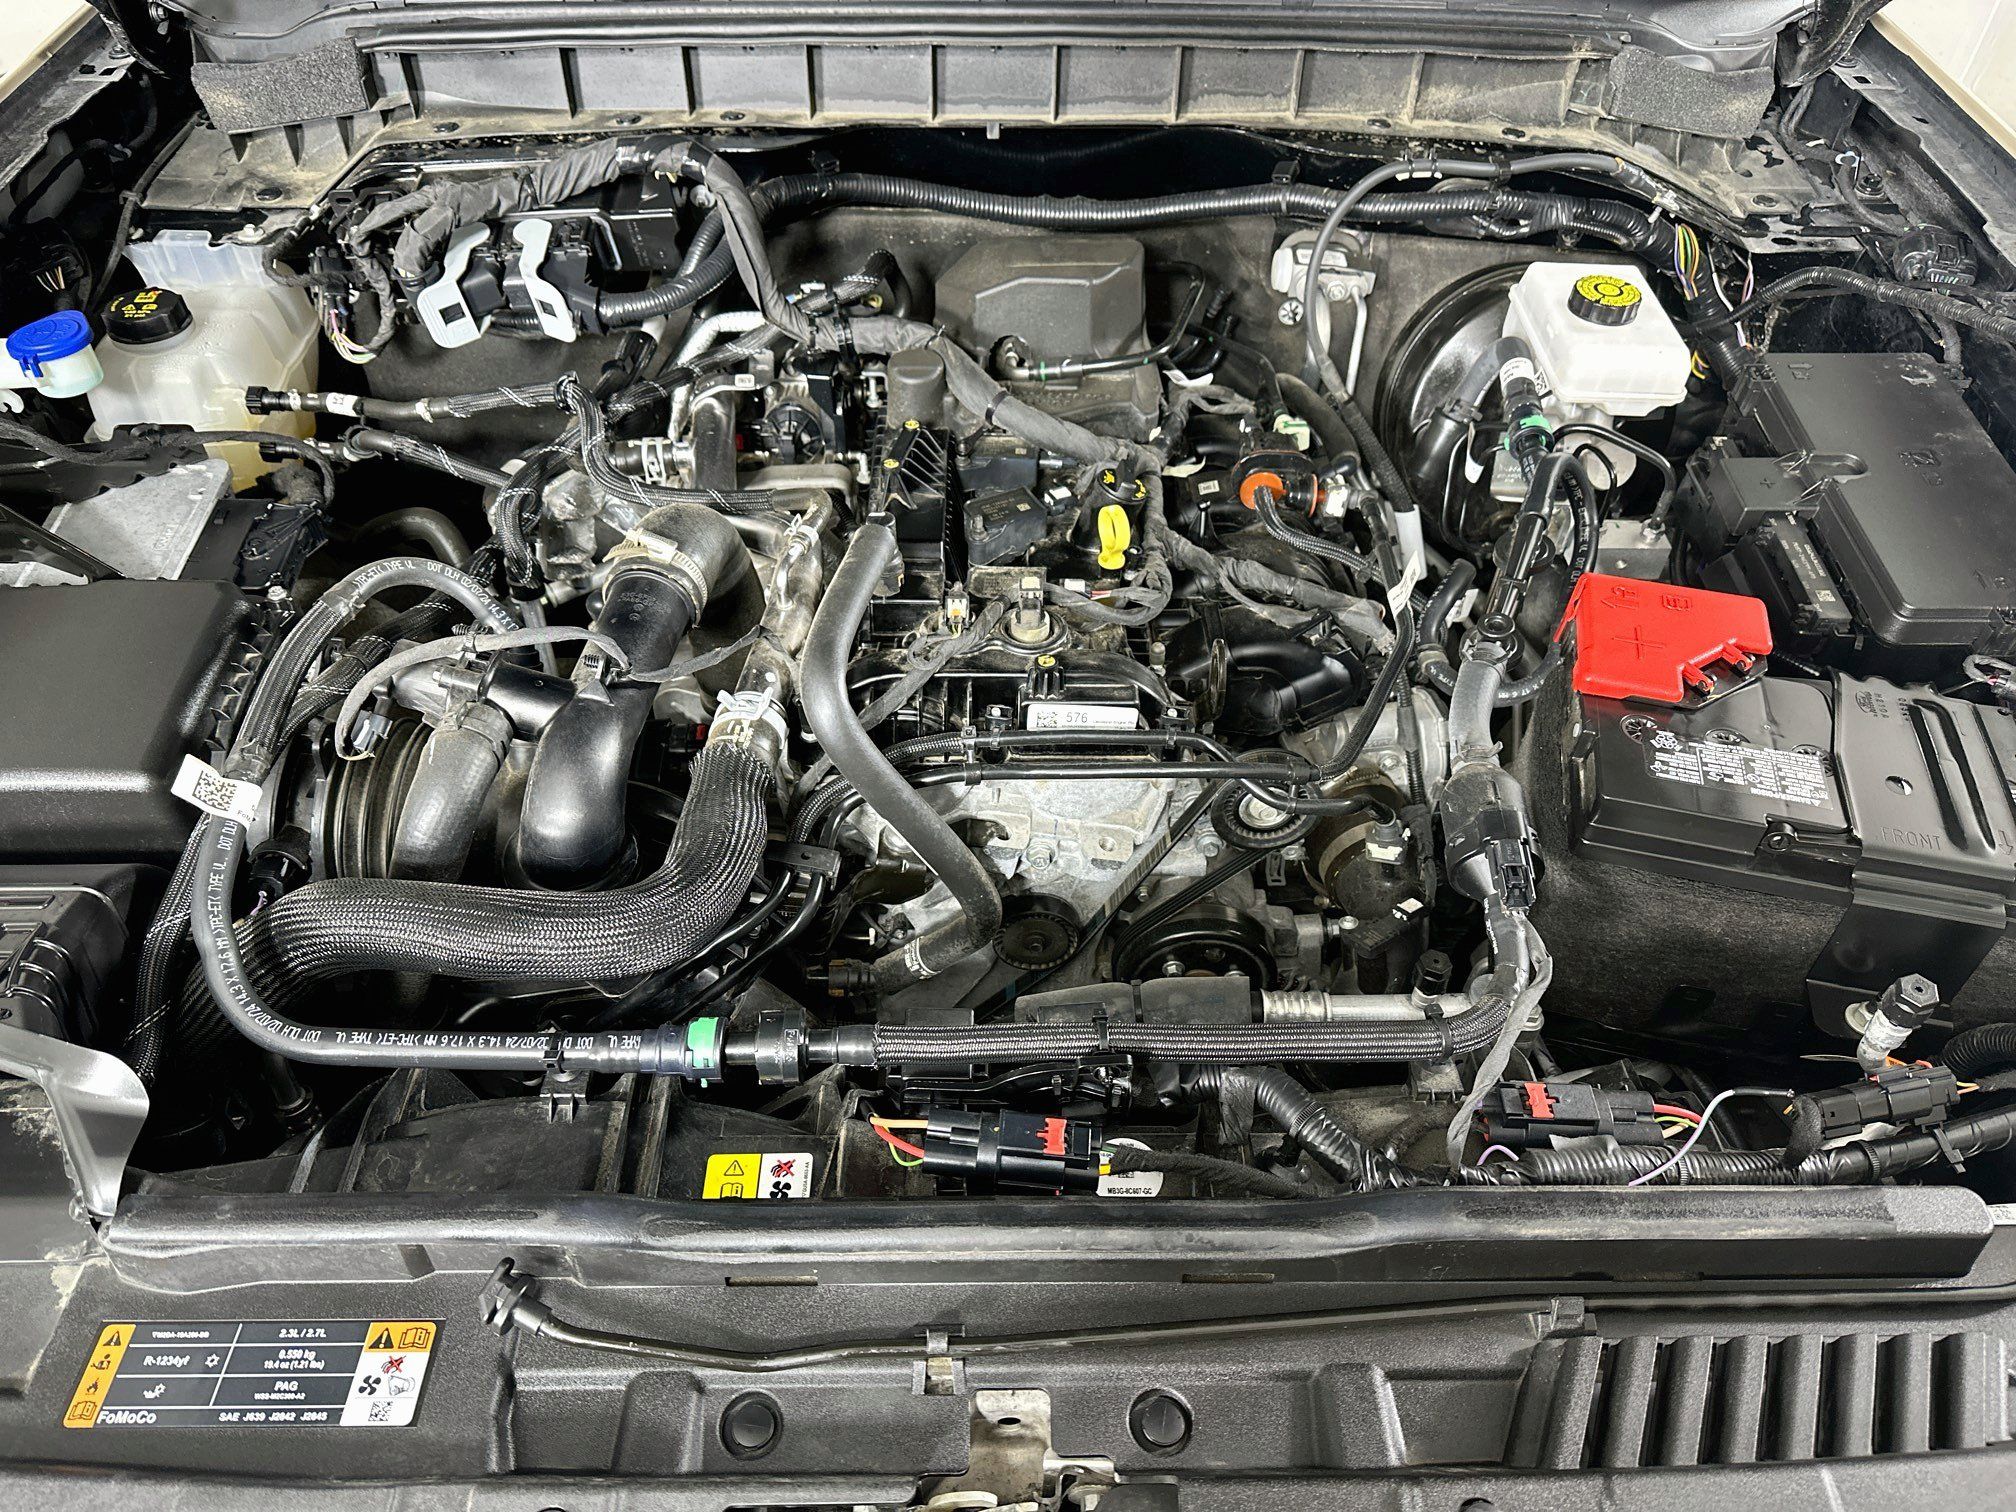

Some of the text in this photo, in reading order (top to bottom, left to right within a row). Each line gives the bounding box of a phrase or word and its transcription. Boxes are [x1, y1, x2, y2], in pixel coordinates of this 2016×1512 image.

[383, 560, 404, 573] TYPE
[427, 562, 442, 573] DOT
[445, 566, 460, 580] DLH
[460, 576, 491, 605] 02/07/24
[1066, 711, 1089, 724] 576
[224, 819, 240, 835] DLH
[217, 835, 234, 851] DOT
[1880, 827, 1942, 850] FRONT
[207, 872, 224, 894] TYPE
[215, 937, 230, 951] MM
[220, 951, 236, 974] 17.6
[226, 975, 240, 986] X
[230, 984, 251, 1006] 14.3
[245, 1003, 284, 1034] 02/07/24
[281, 1025, 302, 1041] DLH
[300, 1030, 322, 1043] DOT
[349, 1031, 373, 1045] TYPE
[422, 1034, 438, 1046] MM
[440, 1034, 463, 1047] 17.6
[467, 1035, 476, 1047] X
[479, 1036, 501, 1049] 14.3
[575, 1036, 594, 1049] DOT
[278, 1328, 300, 1338] 2.3L
[306, 1328, 327, 1338] 2.7L
[143, 1355, 190, 1368] R-1234yf
[278, 1349, 316, 1361] 0.550 kg
[264, 1360, 280, 1369] 19.4
[274, 1380, 299, 1391] PAG
[96, 1410, 157, 1424] FoMoCo
[218, 1412, 240, 1421] SAE
[242, 1412, 266, 1421] J639
